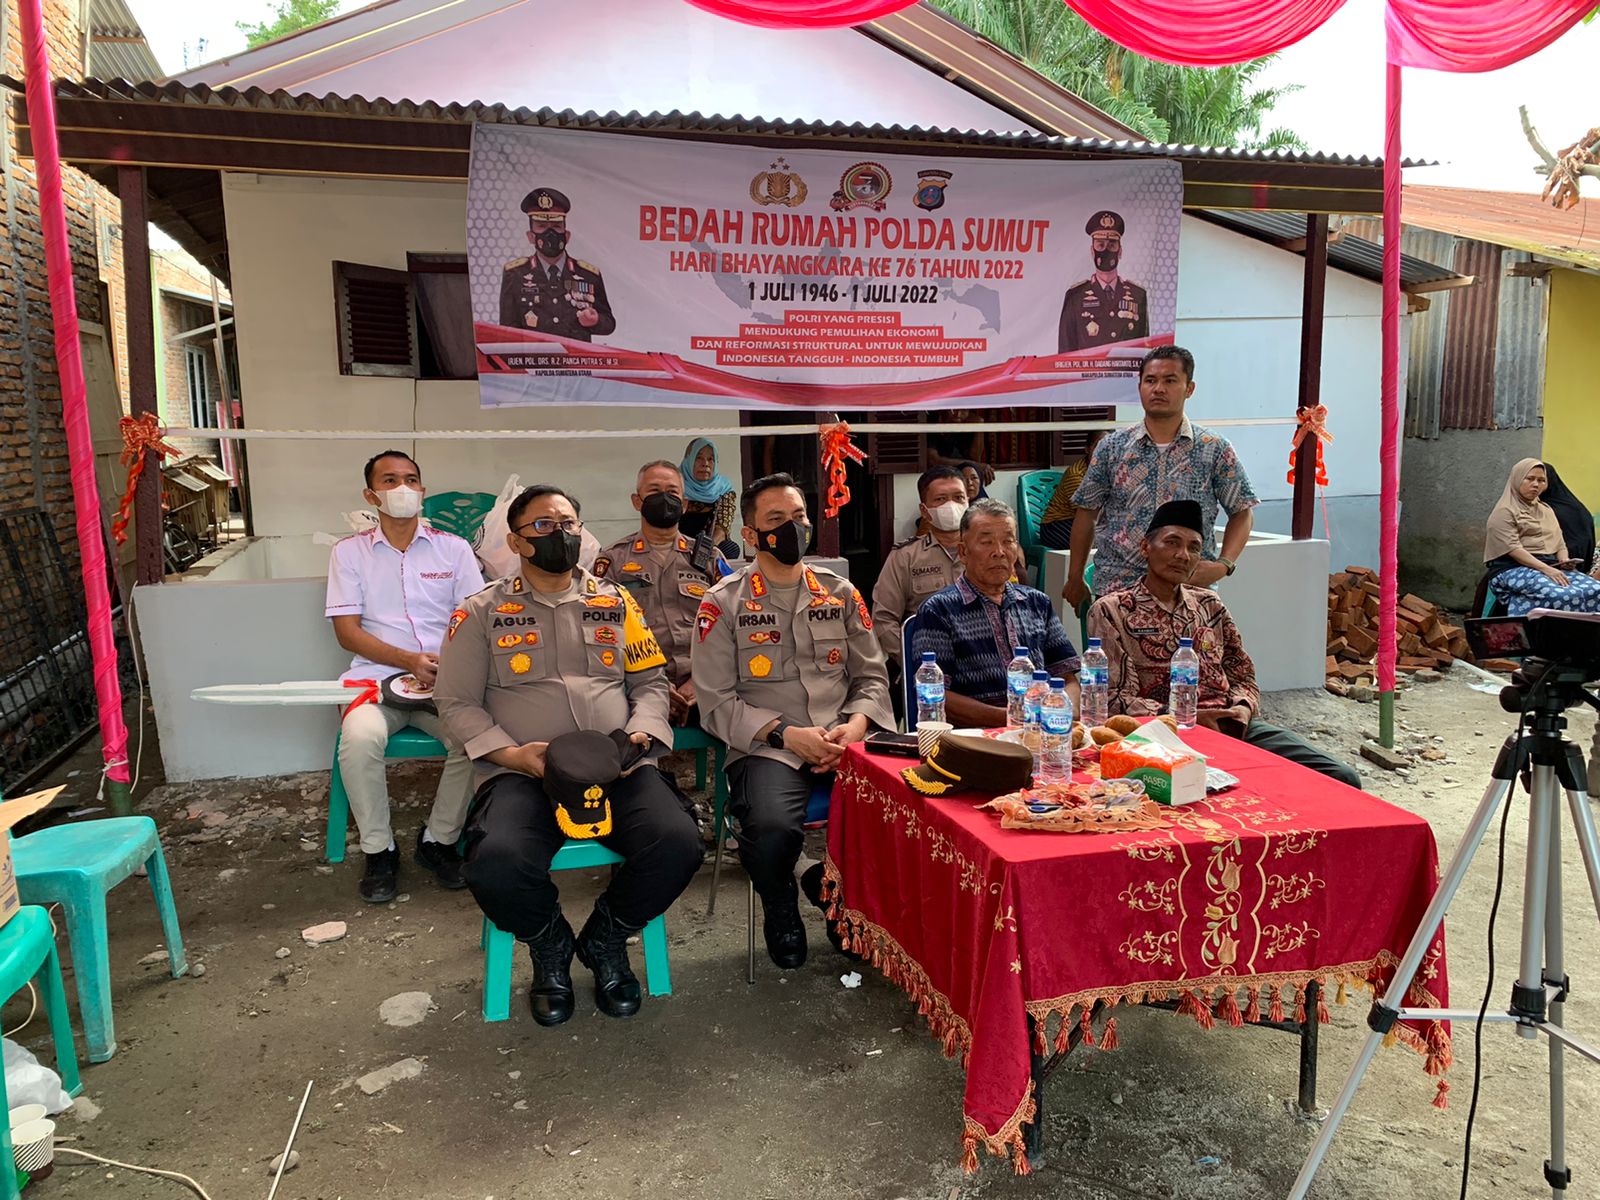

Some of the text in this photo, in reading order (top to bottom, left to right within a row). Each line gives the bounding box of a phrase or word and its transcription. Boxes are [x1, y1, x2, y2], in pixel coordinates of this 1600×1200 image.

[639, 205, 1050, 253] BEDAH RUMAH POLDA SUMUT
[669, 251, 1024, 279] HARI BHAYANGKARA KE 76 TAHUN 2022
[748, 281, 755, 301] 1
[759, 282, 796, 302] JULI
[800, 282, 839, 303] 1946
[852, 284, 859, 302] 1
[862, 285, 897, 303] JULI
[900, 285, 939, 304] 2022
[788, 313, 895, 324] POLRI YANG PRESISI
[744, 326, 939, 337] MENDUKUNG PEMULIHAN EKONOMI
[696, 339, 983, 350] DAN REFORMASI STRUKTURAL UNTUK MEWUJUDKAN
[580, 357, 598, 366] PUTRA
[722, 354, 787, 364] INDONESIA
[788, 354, 843, 364] TANGGUH
[851, 354, 911, 364] INDONESIA
[913, 354, 959, 364] TUMBUH
[582, 611, 621, 623] POLRI
[808, 607, 841, 621] POLRI
[492, 616, 537, 628] AGUS
[738, 614, 776, 628] IRSAN
[1142, 774, 1168, 788] PASEO
